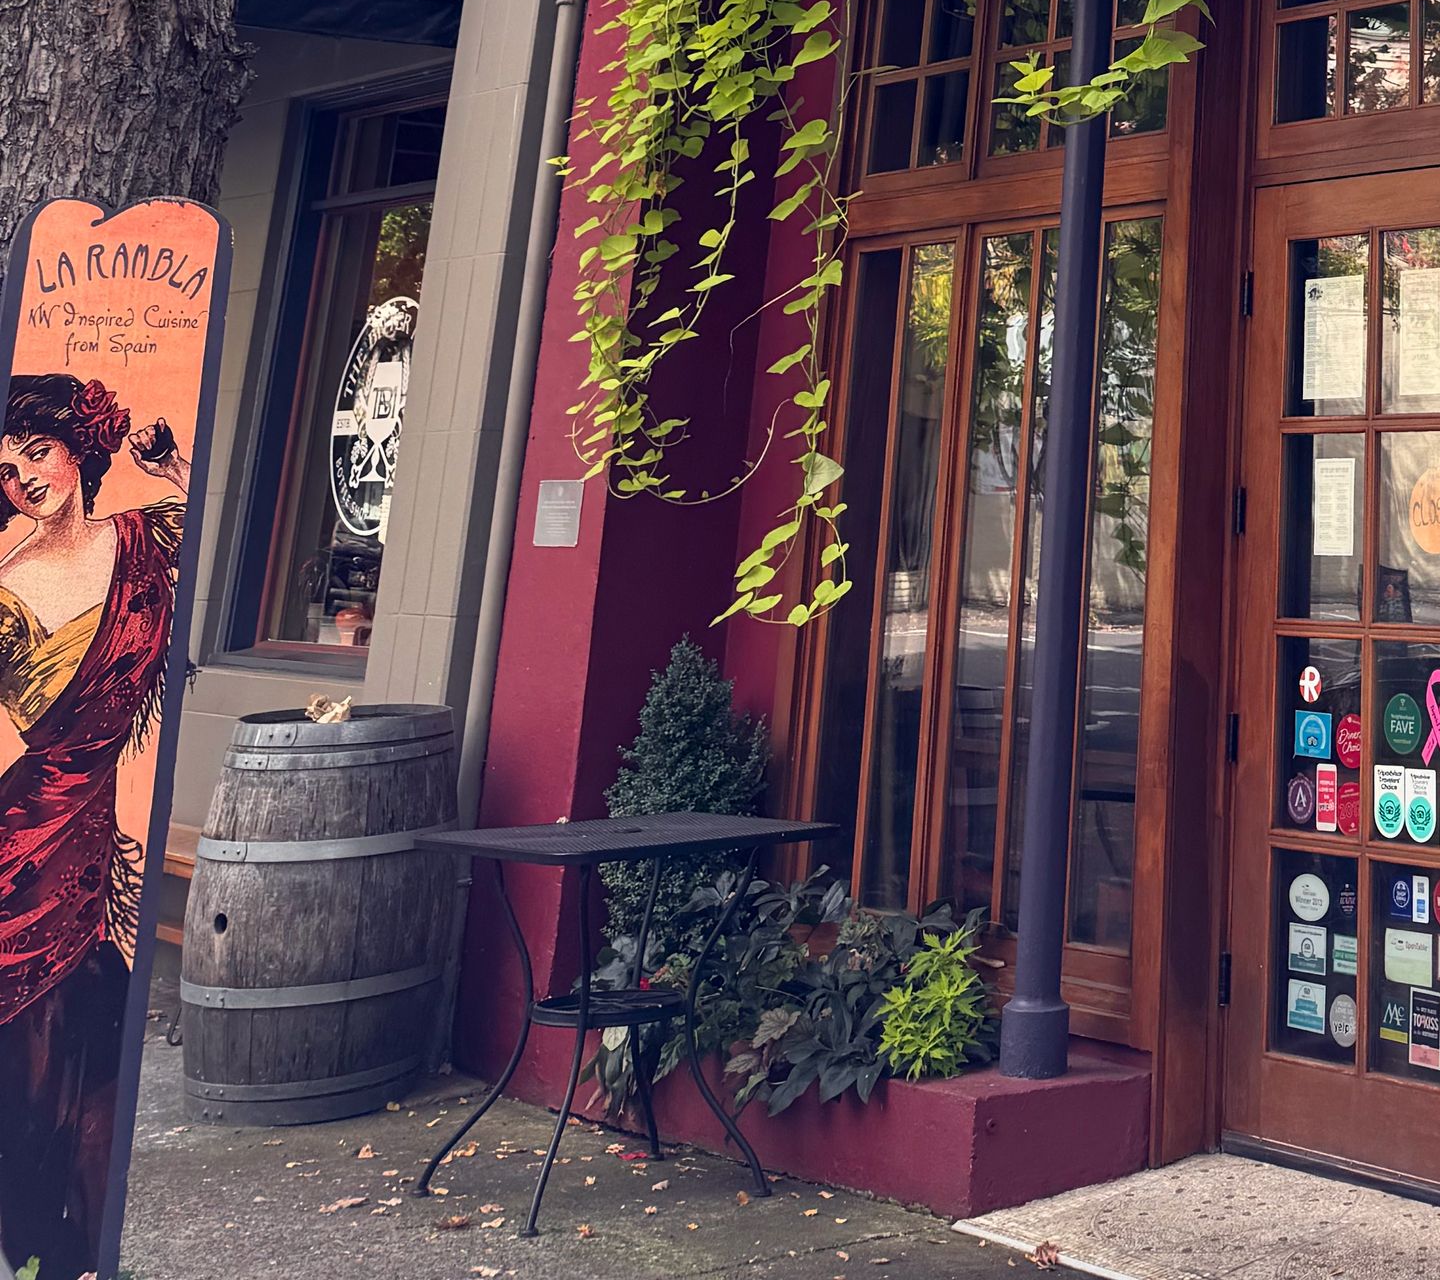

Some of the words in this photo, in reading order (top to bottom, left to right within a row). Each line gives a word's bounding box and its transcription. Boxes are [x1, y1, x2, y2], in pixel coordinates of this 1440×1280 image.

[36, 251, 76, 293] LA
[87, 243, 209, 300] RAMBLA
[28, 301, 61, 329] NW
[63, 301, 135, 336] Inspired
[143, 304, 209, 329] Cuisine
[65, 332, 99, 367] from
[109, 334, 158, 367] Spain
[343, 348, 369, 398] THE
[1390, 720, 1415, 735] FAVE
